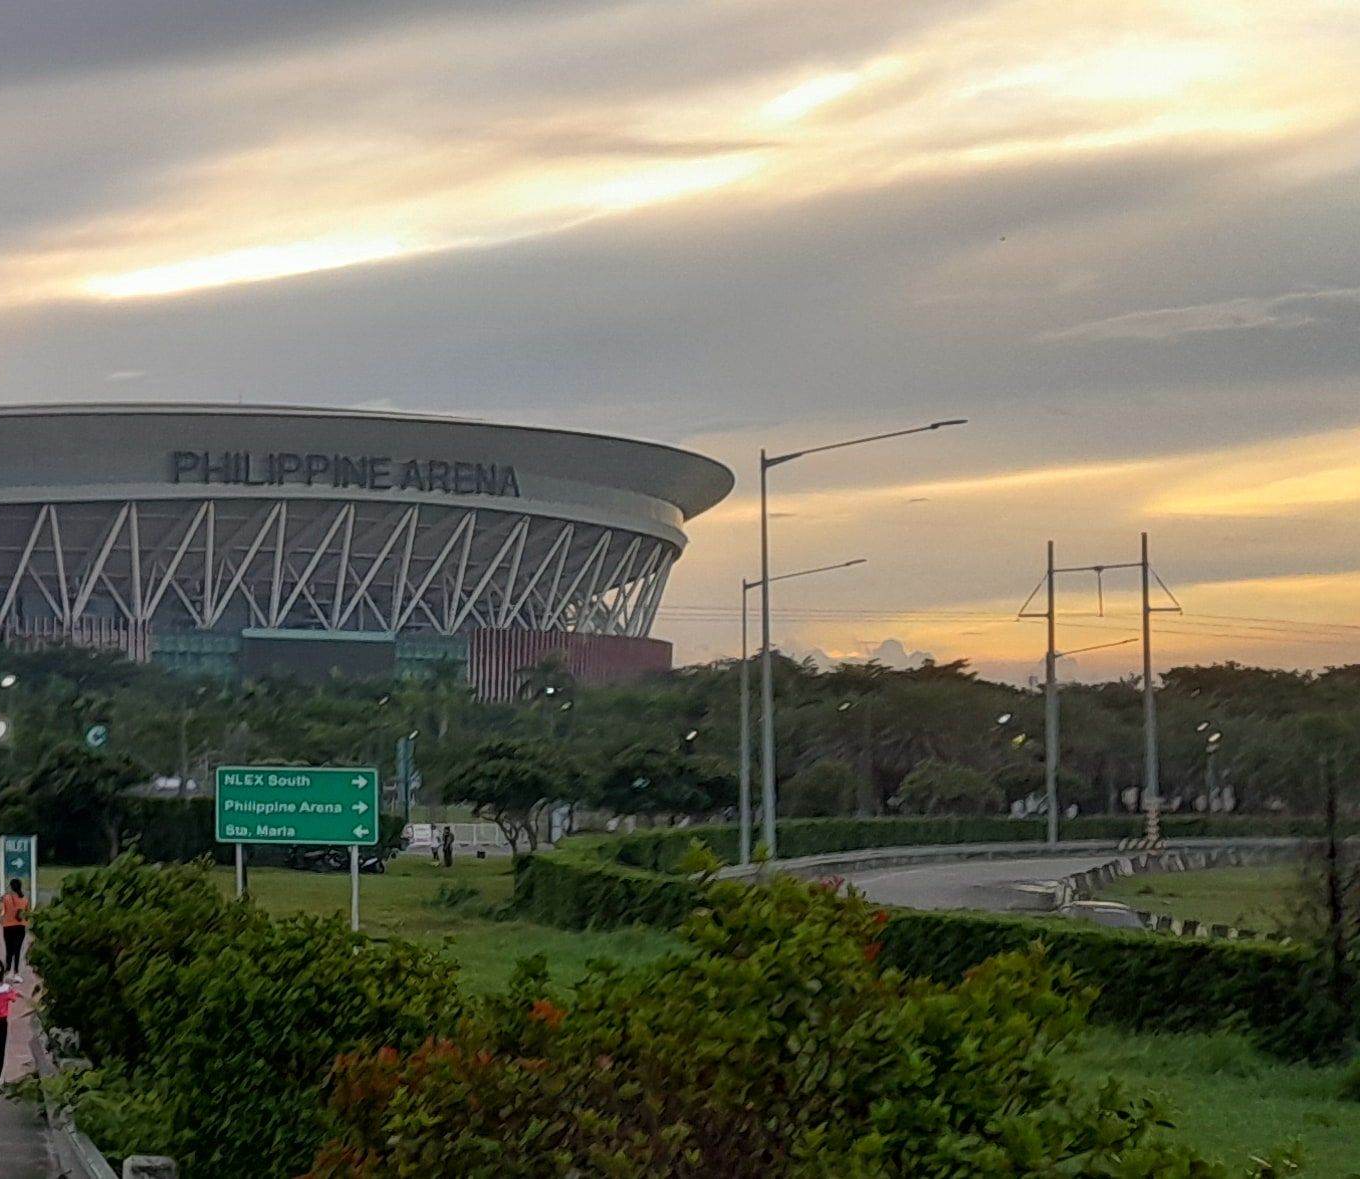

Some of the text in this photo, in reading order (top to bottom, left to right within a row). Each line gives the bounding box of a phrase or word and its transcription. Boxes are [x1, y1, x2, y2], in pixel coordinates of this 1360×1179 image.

[173, 450, 521, 498] PHILIPPINE ARENA
[223, 774, 311, 787] NLEX South
[224, 800, 343, 814] Philippine Arena
[256, 825, 296, 837] Maria
